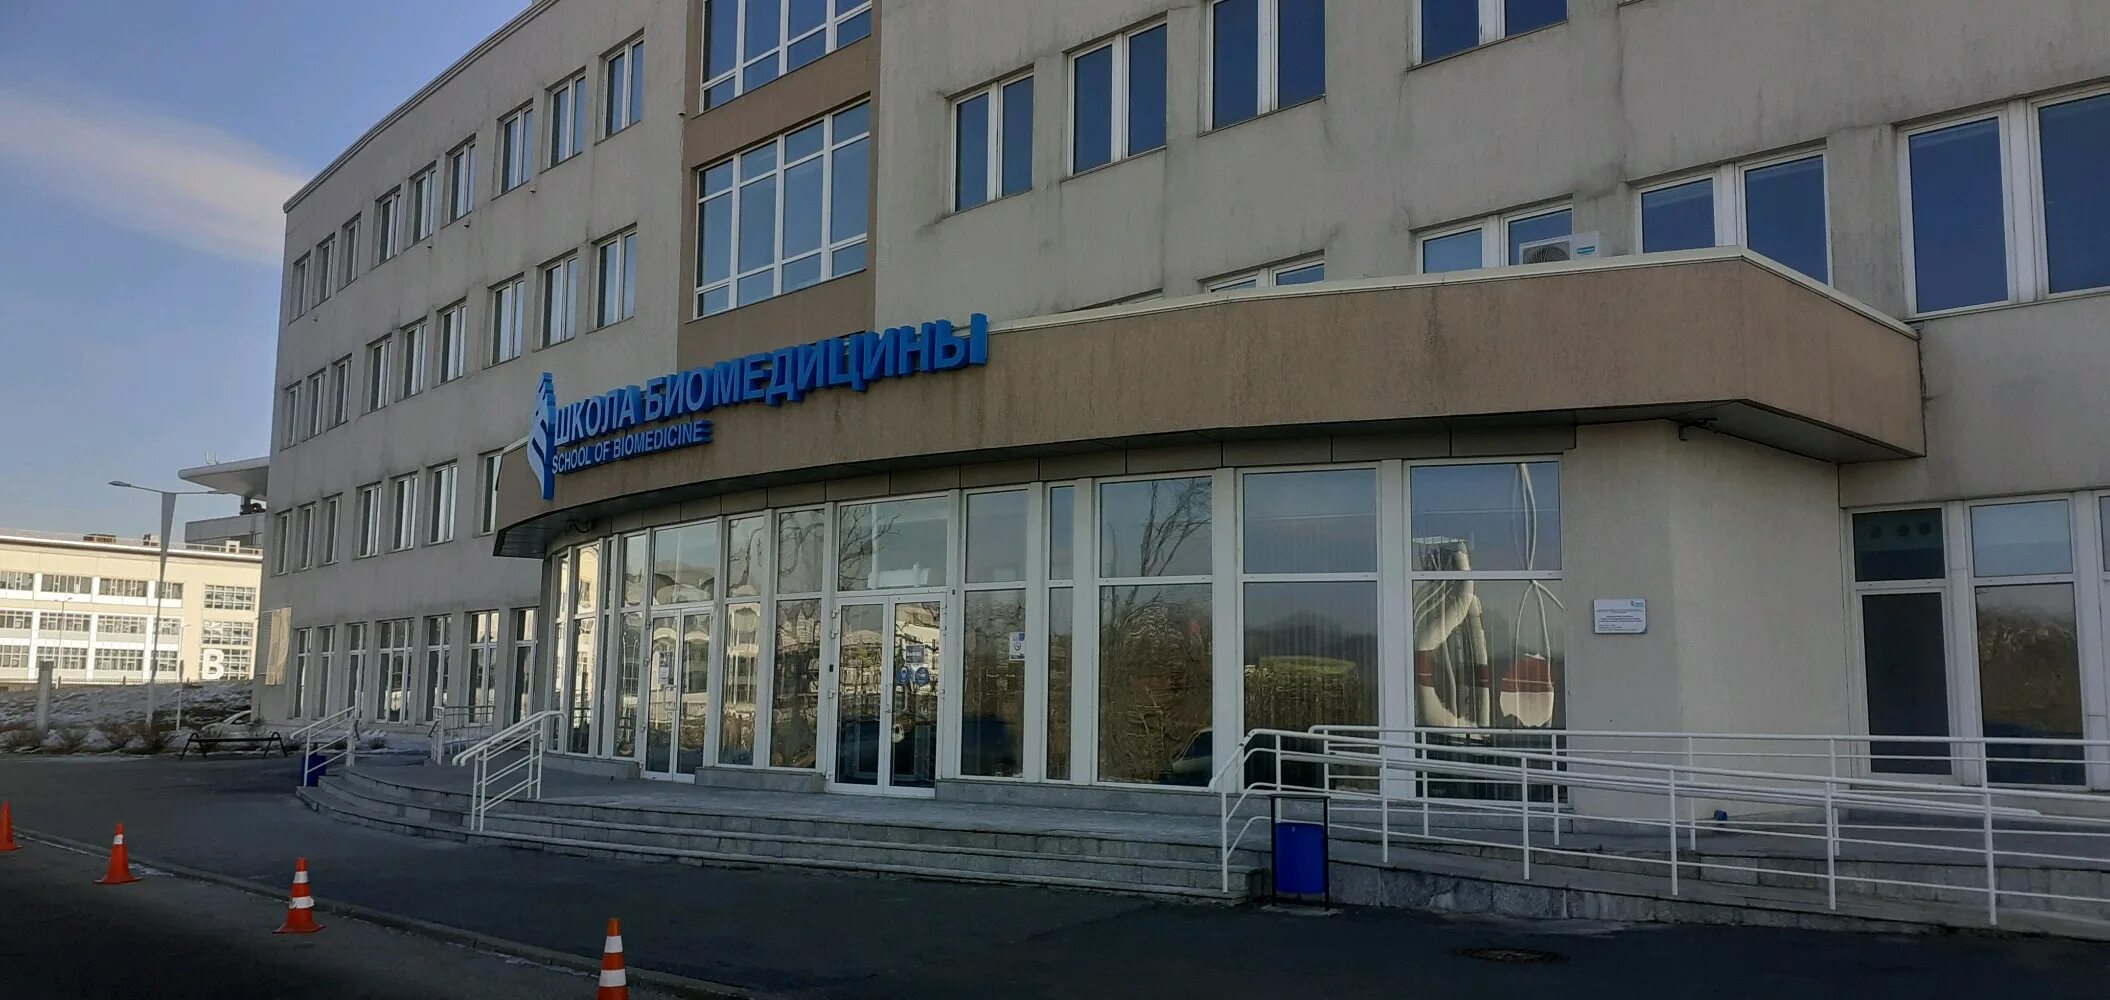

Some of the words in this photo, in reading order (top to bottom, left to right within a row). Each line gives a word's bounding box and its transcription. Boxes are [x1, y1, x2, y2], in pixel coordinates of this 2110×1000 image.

[554, 386, 638, 446] ШКОЛА
[644, 313, 987, 422] БИОМЕДИЦИНЫ
[551, 446, 592, 474] SCHOOL
[594, 441, 611, 463] OF
[613, 420, 704, 459] BIOMEDICINE
